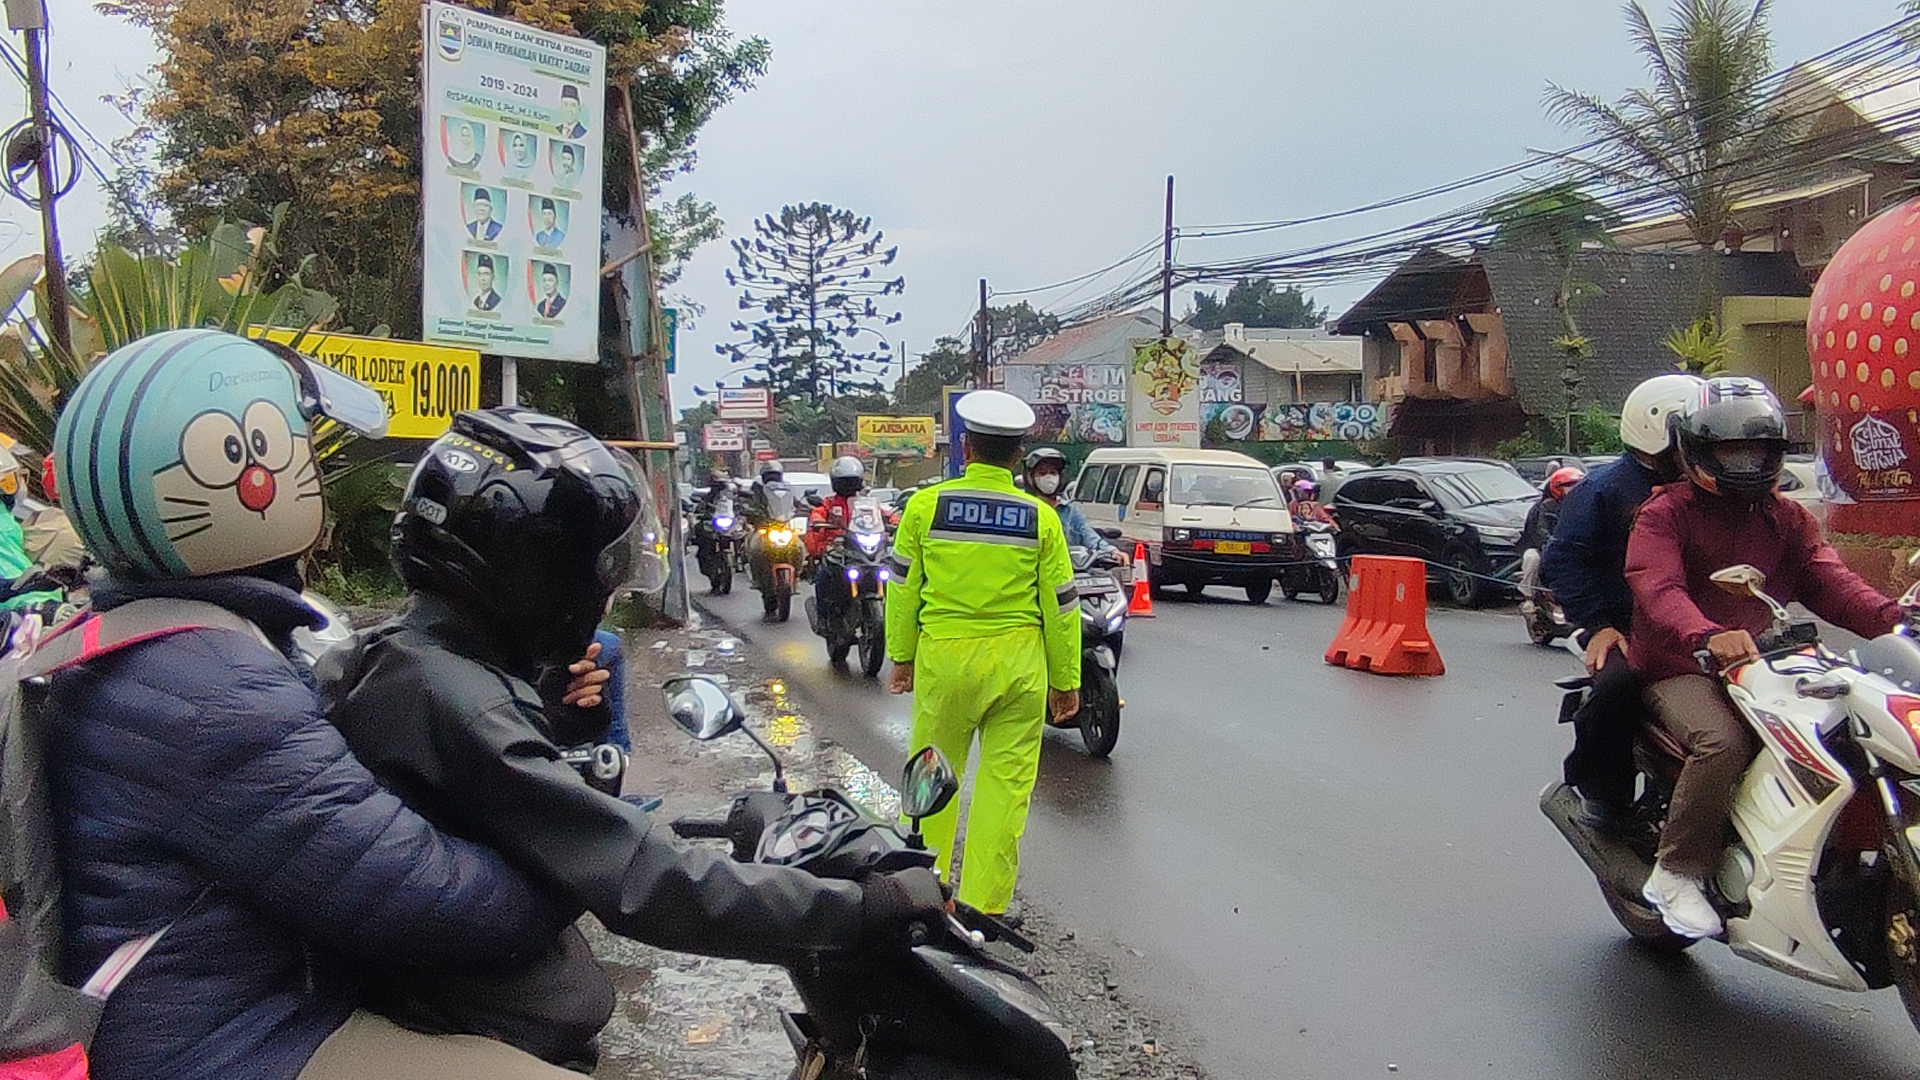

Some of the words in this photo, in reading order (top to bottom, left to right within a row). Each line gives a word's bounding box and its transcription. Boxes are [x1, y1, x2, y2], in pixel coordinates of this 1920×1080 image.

[466, 18, 512, 37] PIMPINAN
[514, 31, 533, 43] DAN
[535, 37, 562, 51] KETUA
[564, 45, 592, 59] KOMISI
[467, 34, 493, 50] DEWAN
[495, 41, 537, 61] PERWAKILAN
[564, 60, 591, 75] DAERAH
[480, 75, 505, 91] 2019
[513, 83, 539, 98] 2024
[362, 356, 406, 385] LODEH
[410, 361, 471, 418] 19.000
[948, 502, 1027, 528] POLISI
